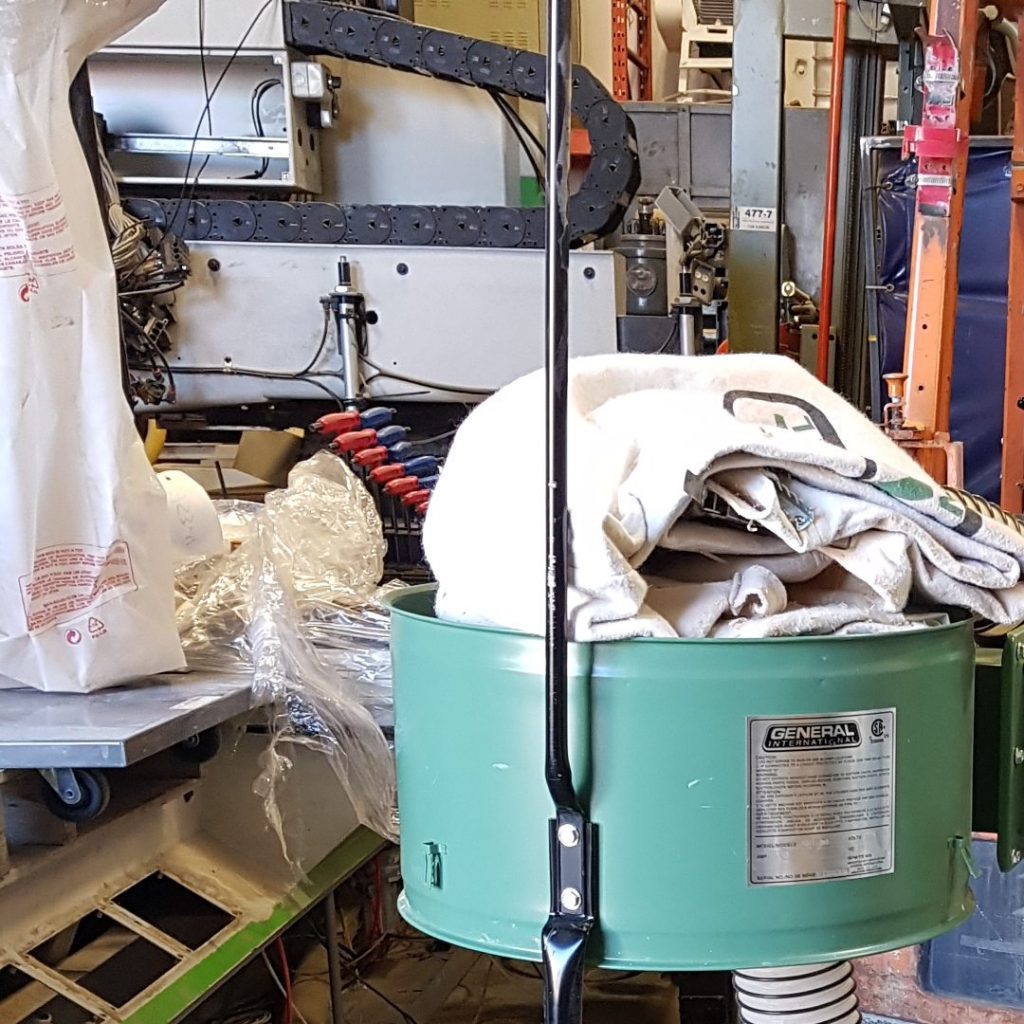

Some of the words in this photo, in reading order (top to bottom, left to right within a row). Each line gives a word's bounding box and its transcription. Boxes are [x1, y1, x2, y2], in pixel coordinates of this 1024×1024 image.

[745, 208, 773, 219] 477-7
[770, 724, 855, 740] GENERAL
[768, 737, 857, 748] INTERNATIONAL
